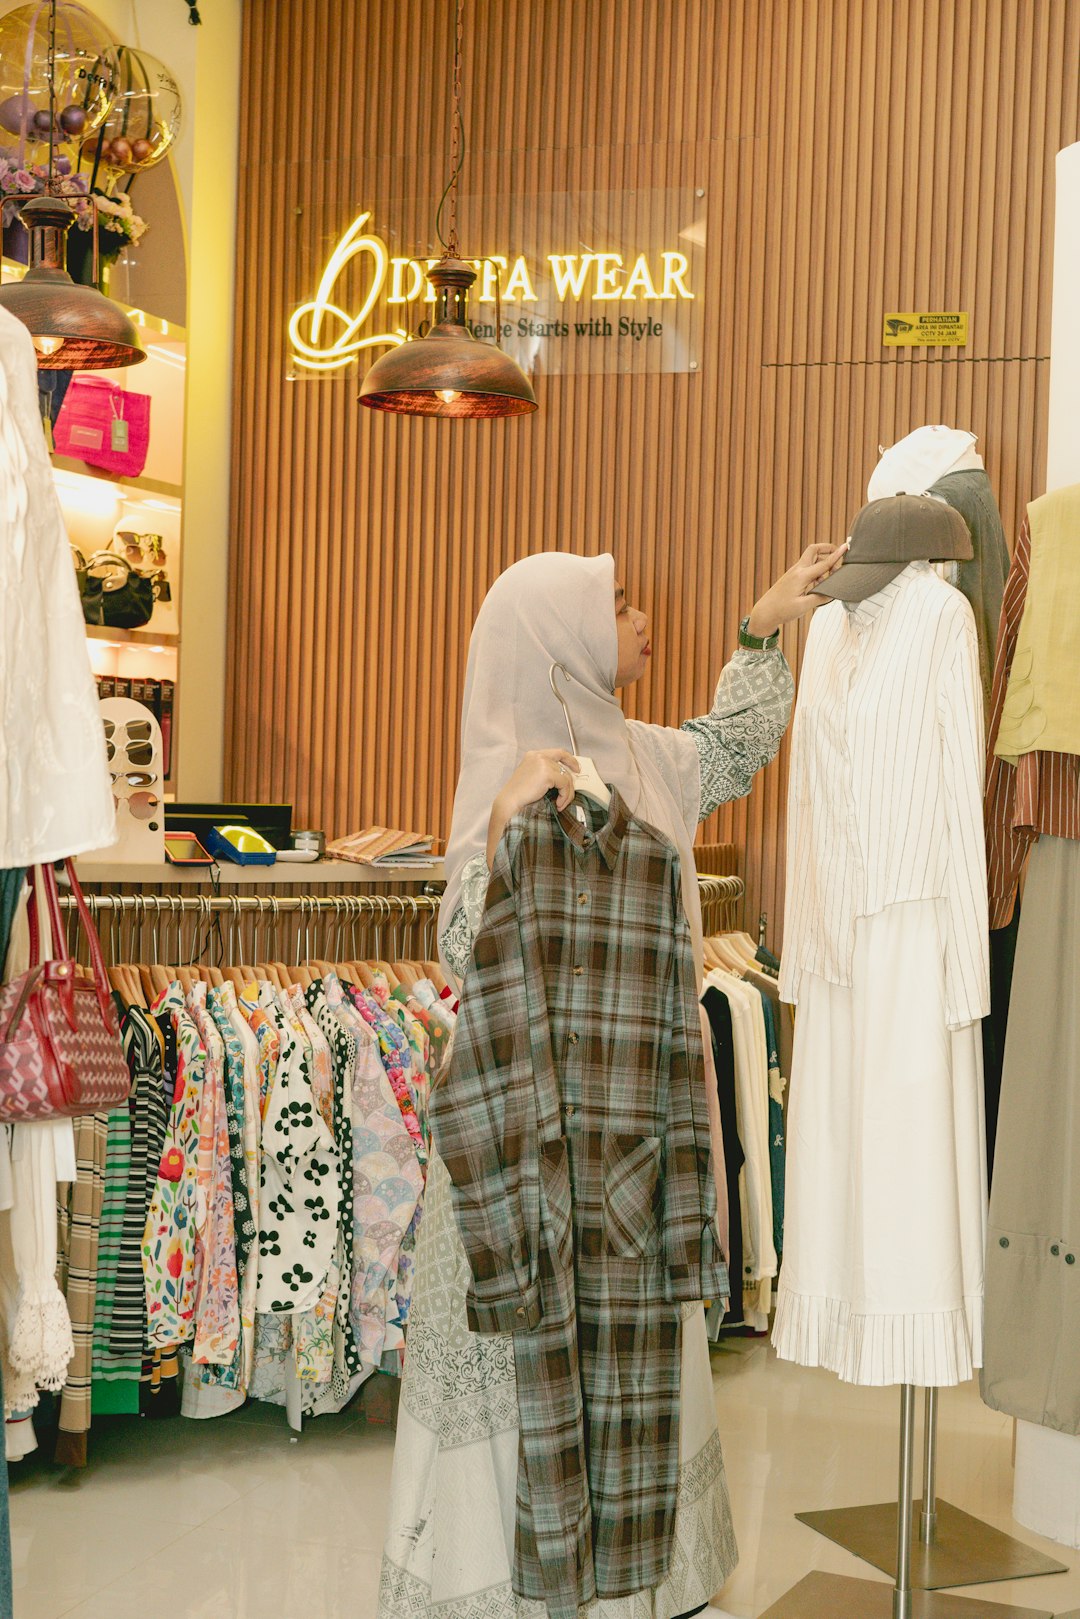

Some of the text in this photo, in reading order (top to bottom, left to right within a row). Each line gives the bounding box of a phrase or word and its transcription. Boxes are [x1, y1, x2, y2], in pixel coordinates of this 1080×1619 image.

[386, 252, 695, 304] DFA WEAR
[517, 317, 569, 337] Starts
[573, 316, 613, 337] with
[618, 316, 663, 341] Style
